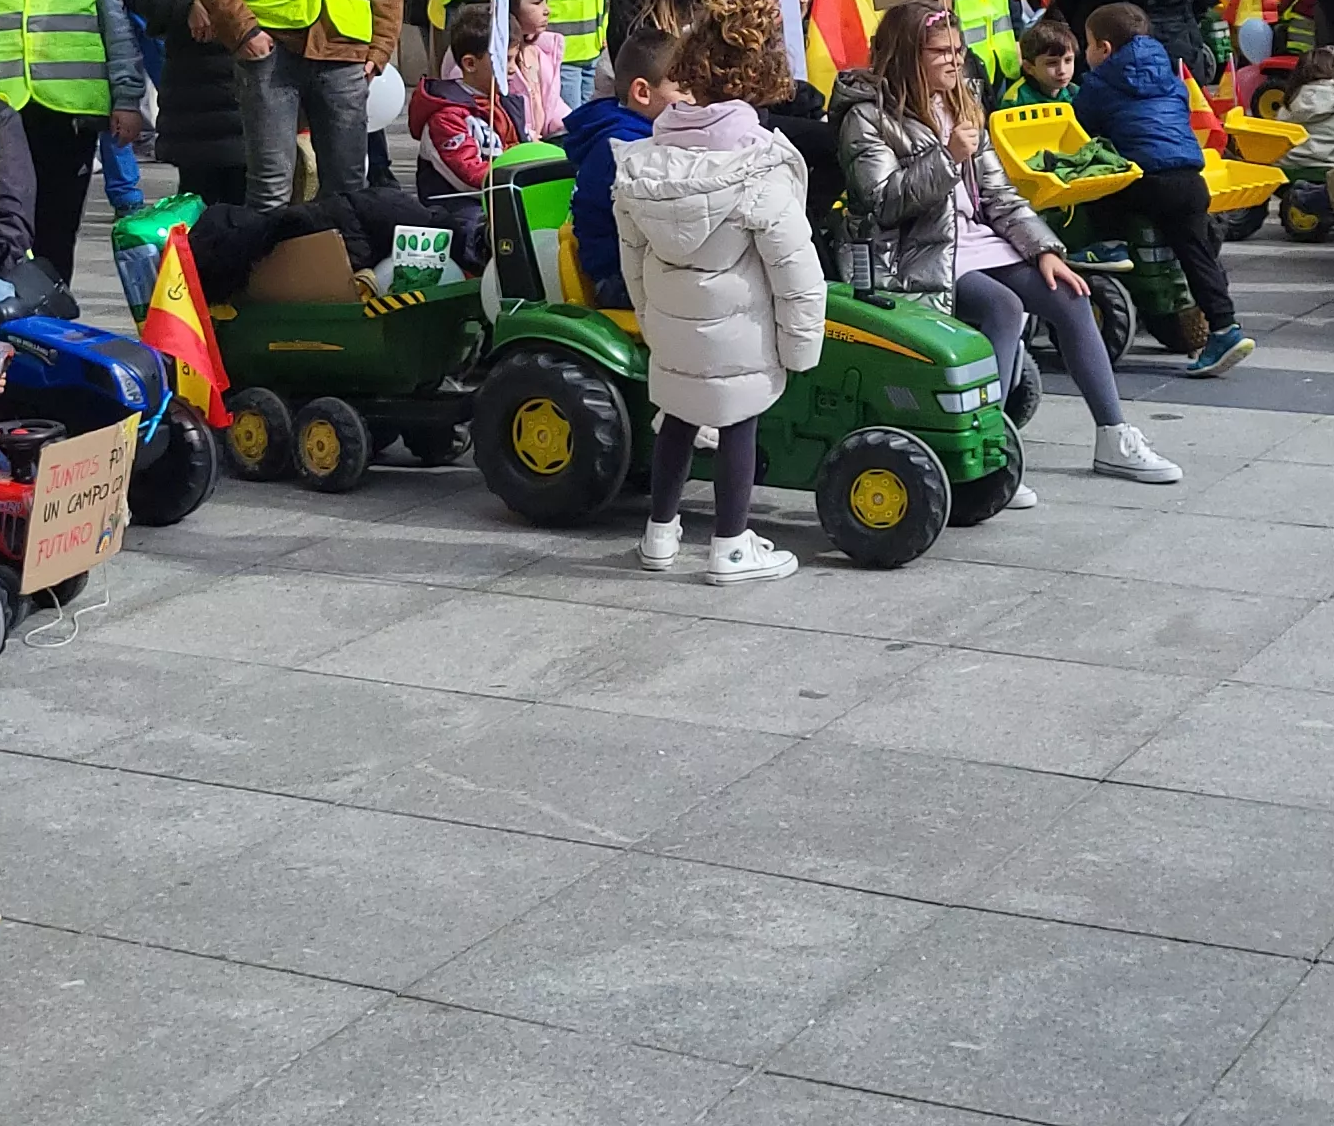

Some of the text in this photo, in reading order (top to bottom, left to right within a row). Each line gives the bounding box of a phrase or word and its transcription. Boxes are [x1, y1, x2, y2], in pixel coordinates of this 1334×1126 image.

[46, 455, 100, 494] JUNTOS
[43, 500, 60, 523] UN
[68, 483, 110, 514] CAMPO
[36, 521, 94, 567] FUTURO
